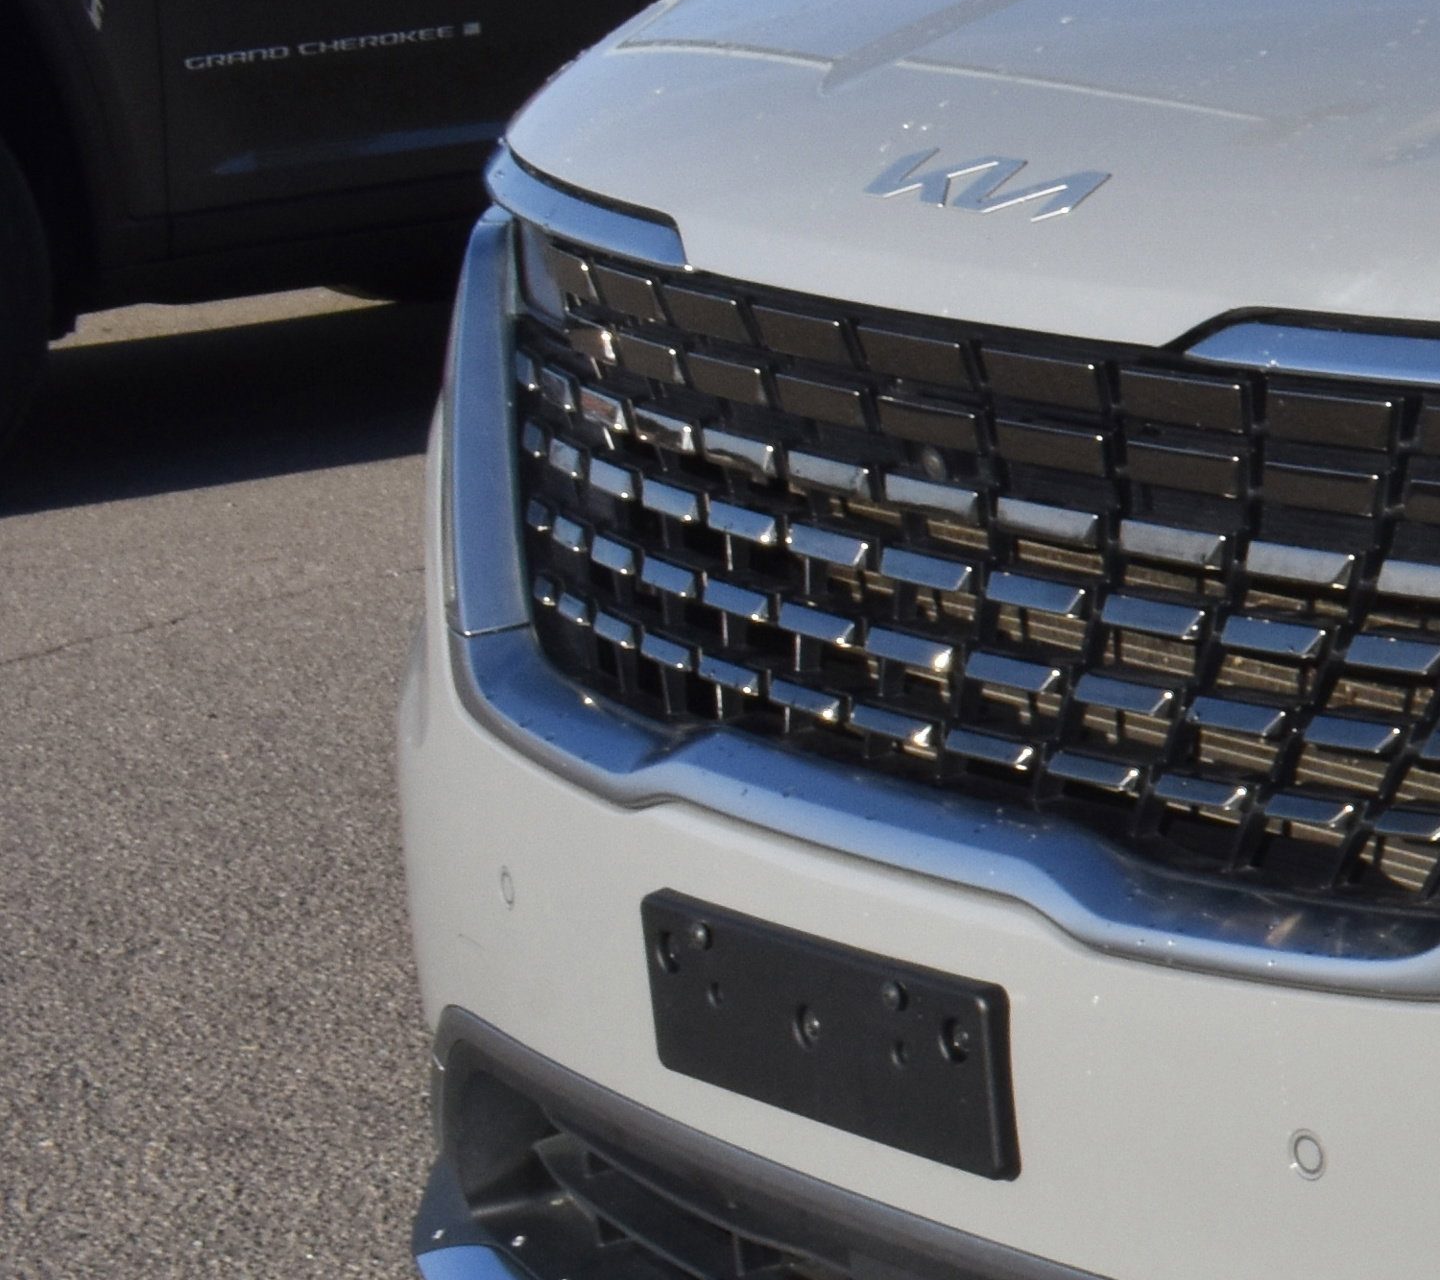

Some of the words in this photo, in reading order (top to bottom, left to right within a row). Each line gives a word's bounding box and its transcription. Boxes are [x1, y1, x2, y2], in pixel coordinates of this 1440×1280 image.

[184, 46, 290, 71] GRAND
[298, 26, 454, 56] CHEROKEE
[862, 147, 1112, 222] KIA
